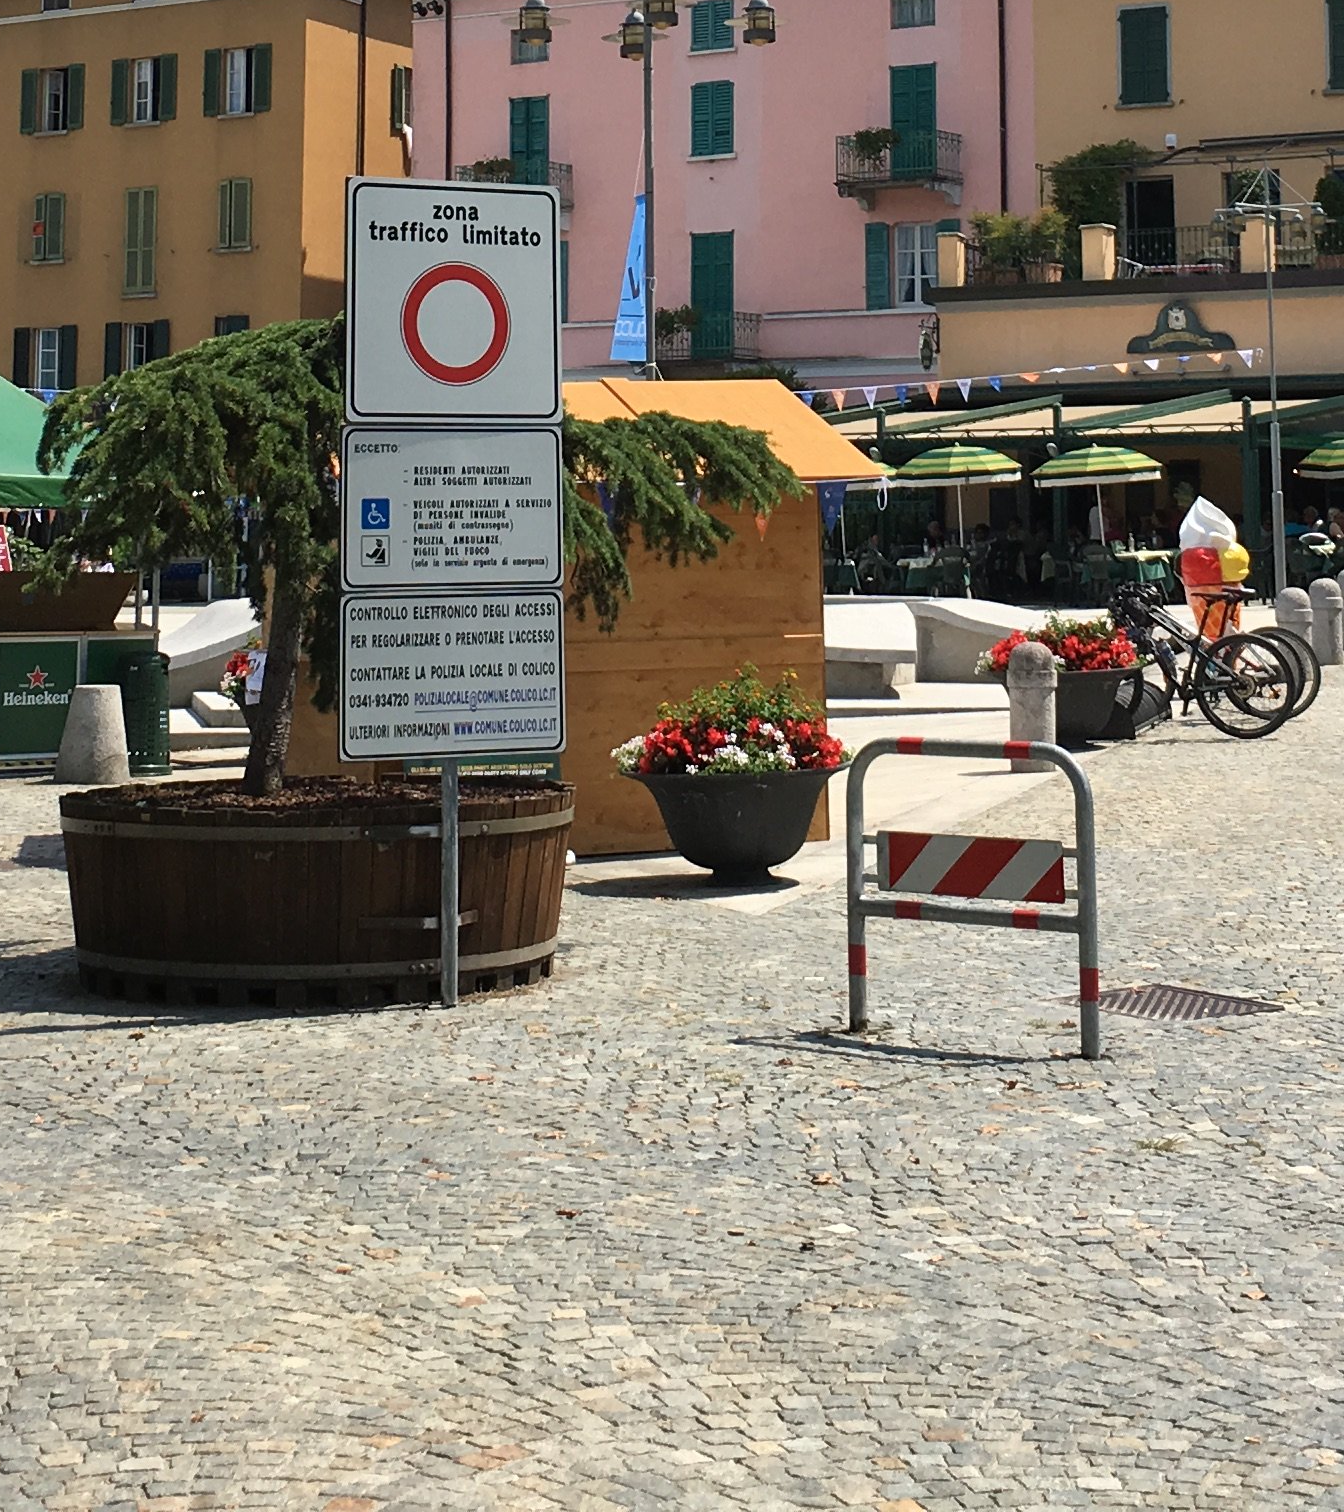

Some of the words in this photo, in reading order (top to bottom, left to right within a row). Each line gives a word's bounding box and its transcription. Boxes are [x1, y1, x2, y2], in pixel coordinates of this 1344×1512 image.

[433, 205, 479, 221] zona
[369, 221, 448, 243] traffico
[463, 225, 541, 246] limitato
[414, 466, 455, 475] RESIDENTI
[462, 466, 510, 475] AUTORIZZATI
[414, 477, 435, 486] ALTRI
[442, 477, 477, 486] SOGGETTI
[483, 477, 532, 485] AUTORIZZATI
[413, 500, 444, 509] VEICOLI
[450, 500, 498, 508] AUTORIZZATI
[505, 500, 510, 508] A
[516, 499, 552, 508] SERVIZIO
[414, 511, 422, 519] DI
[429, 511, 464, 519] PERSONE
[470, 510, 506, 519] INVALIDE
[448, 521, 455, 529] di
[413, 547, 438, 555] VIGILI
[445, 547, 459, 555] DEL
[465, 547, 489, 555] FUOCO
[502, 557, 508, 565] di
[350, 606, 408, 621] CONTROLLO
[413, 605, 478, 619] ELETTRONICO
[483, 604, 509, 617] DEGLI
[515, 603, 556, 617] ACCESSI
[351, 634, 367, 648] PER
[372, 632, 440, 648] REGOLARIZZARE
[445, 632, 451, 645] O
[456, 630, 504, 645] PRENOTARE
[509, 629, 554, 643] L'ACCESSO
[350, 666, 410, 681] CONTATTARE
[415, 666, 426, 680] LA
[431, 664, 465, 679] POLIZIA
[470, 663, 503, 678] LOCALE
[508, 663, 517, 676] DI
[522, 662, 555, 676] COLICO
[3, 689, 69, 706] Heineken
[350, 693, 409, 708] 0341-934720
[415, 687, 556, 711] POLIZIALOCALE@COMUNE.COLICO.LC.IT
[350, 725, 389, 740] ULTERIORI
[394, 723, 450, 739] INFORMAZIONI
[454, 718, 557, 736] WWW.COMUNE.COLICO.LC.IT
